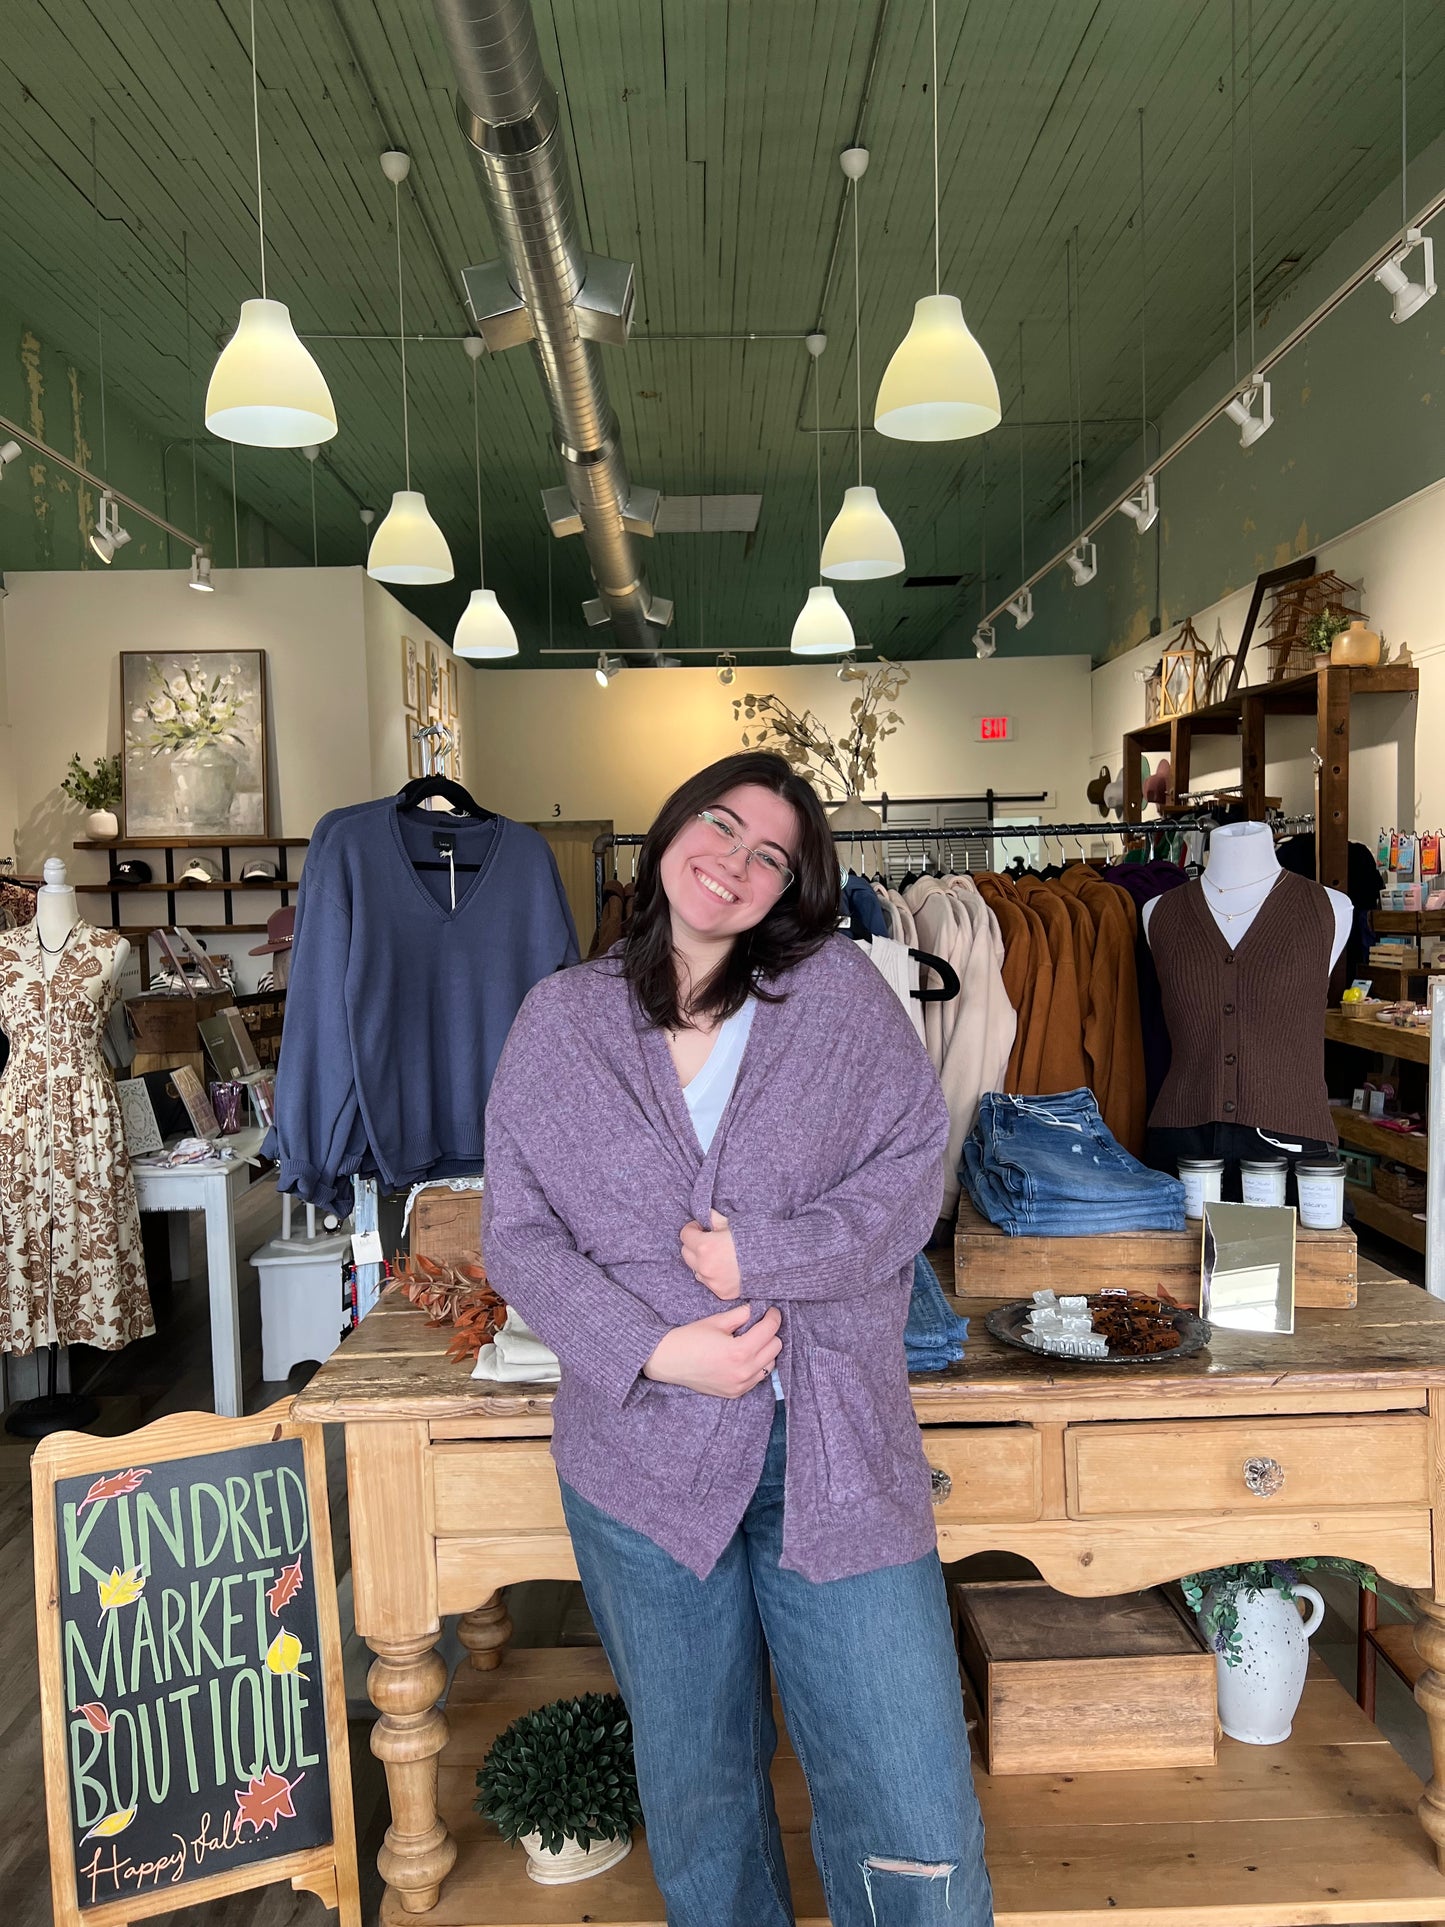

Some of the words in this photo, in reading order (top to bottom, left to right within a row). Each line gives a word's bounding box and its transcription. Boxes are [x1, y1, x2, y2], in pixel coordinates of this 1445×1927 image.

[981, 717, 1008, 740] EXIT
[551, 803, 561, 817] 3
[62, 1466, 309, 1595] KINDRED
[64, 1567, 275, 1711] MARKET
[69, 1652, 320, 1829] BOUTIQUE
[80, 1833, 187, 1903] Happy
